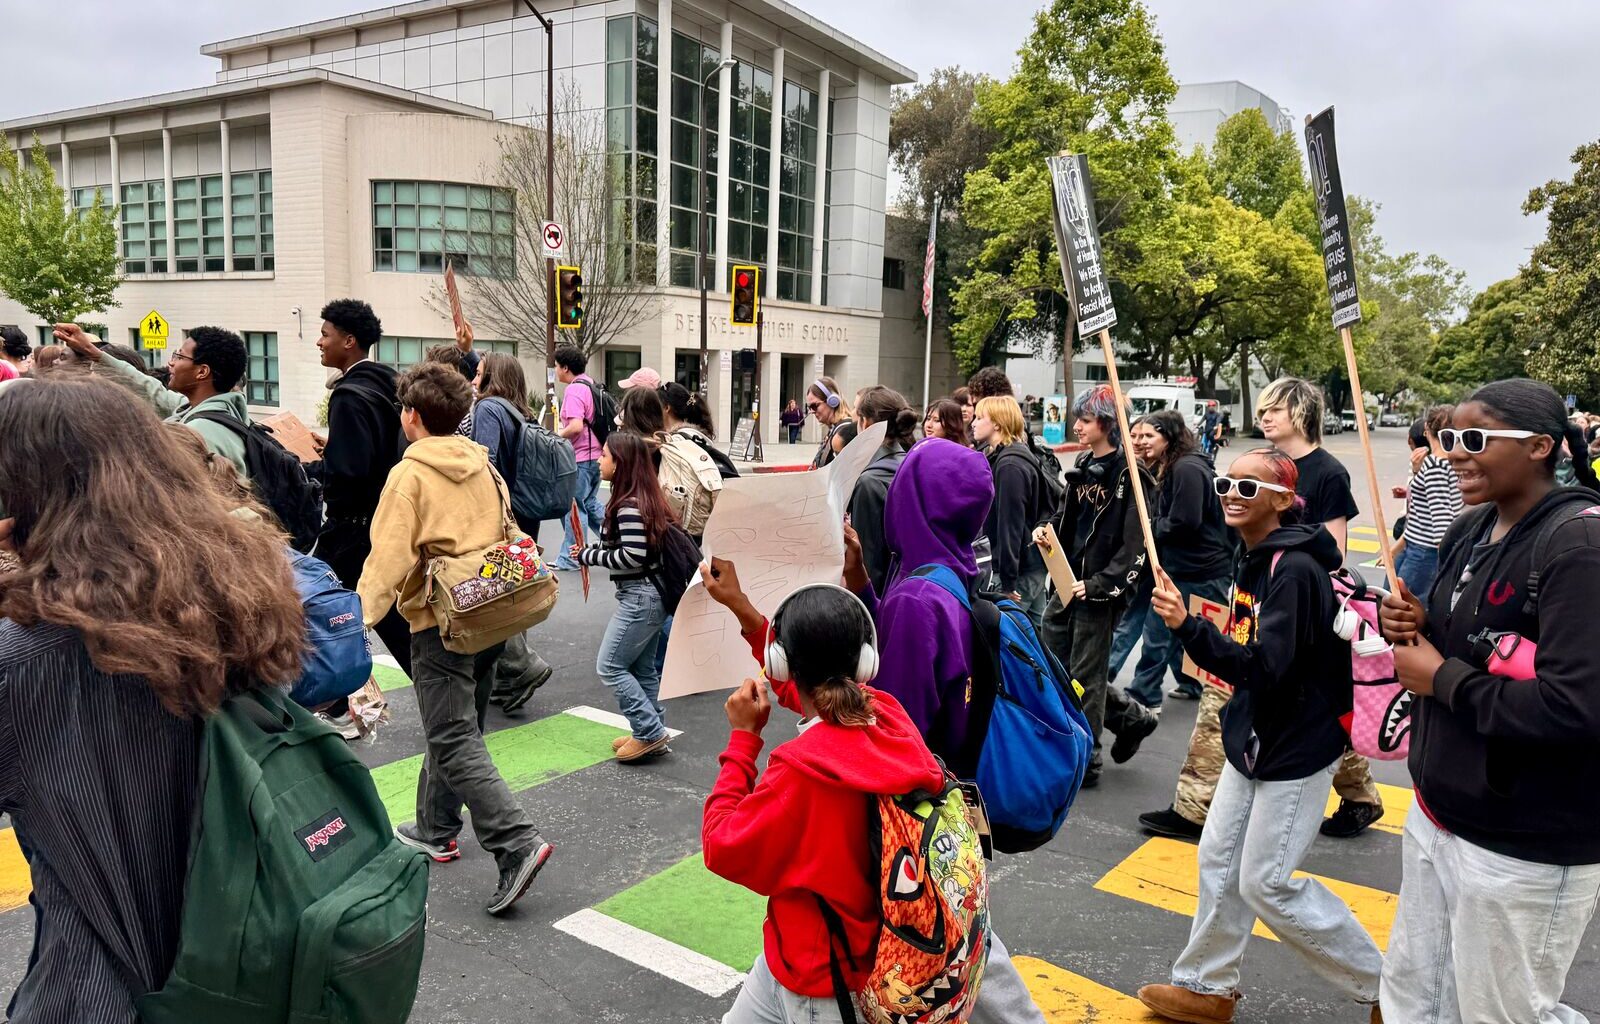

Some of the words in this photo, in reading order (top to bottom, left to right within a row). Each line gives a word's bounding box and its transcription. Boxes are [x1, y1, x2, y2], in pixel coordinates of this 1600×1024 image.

[1079, 302, 1099, 316] Fascist
[763, 320, 794, 338] HIGH
[802, 324, 849, 342] SCHOOL
[750, 494, 828, 605] HUMAN
